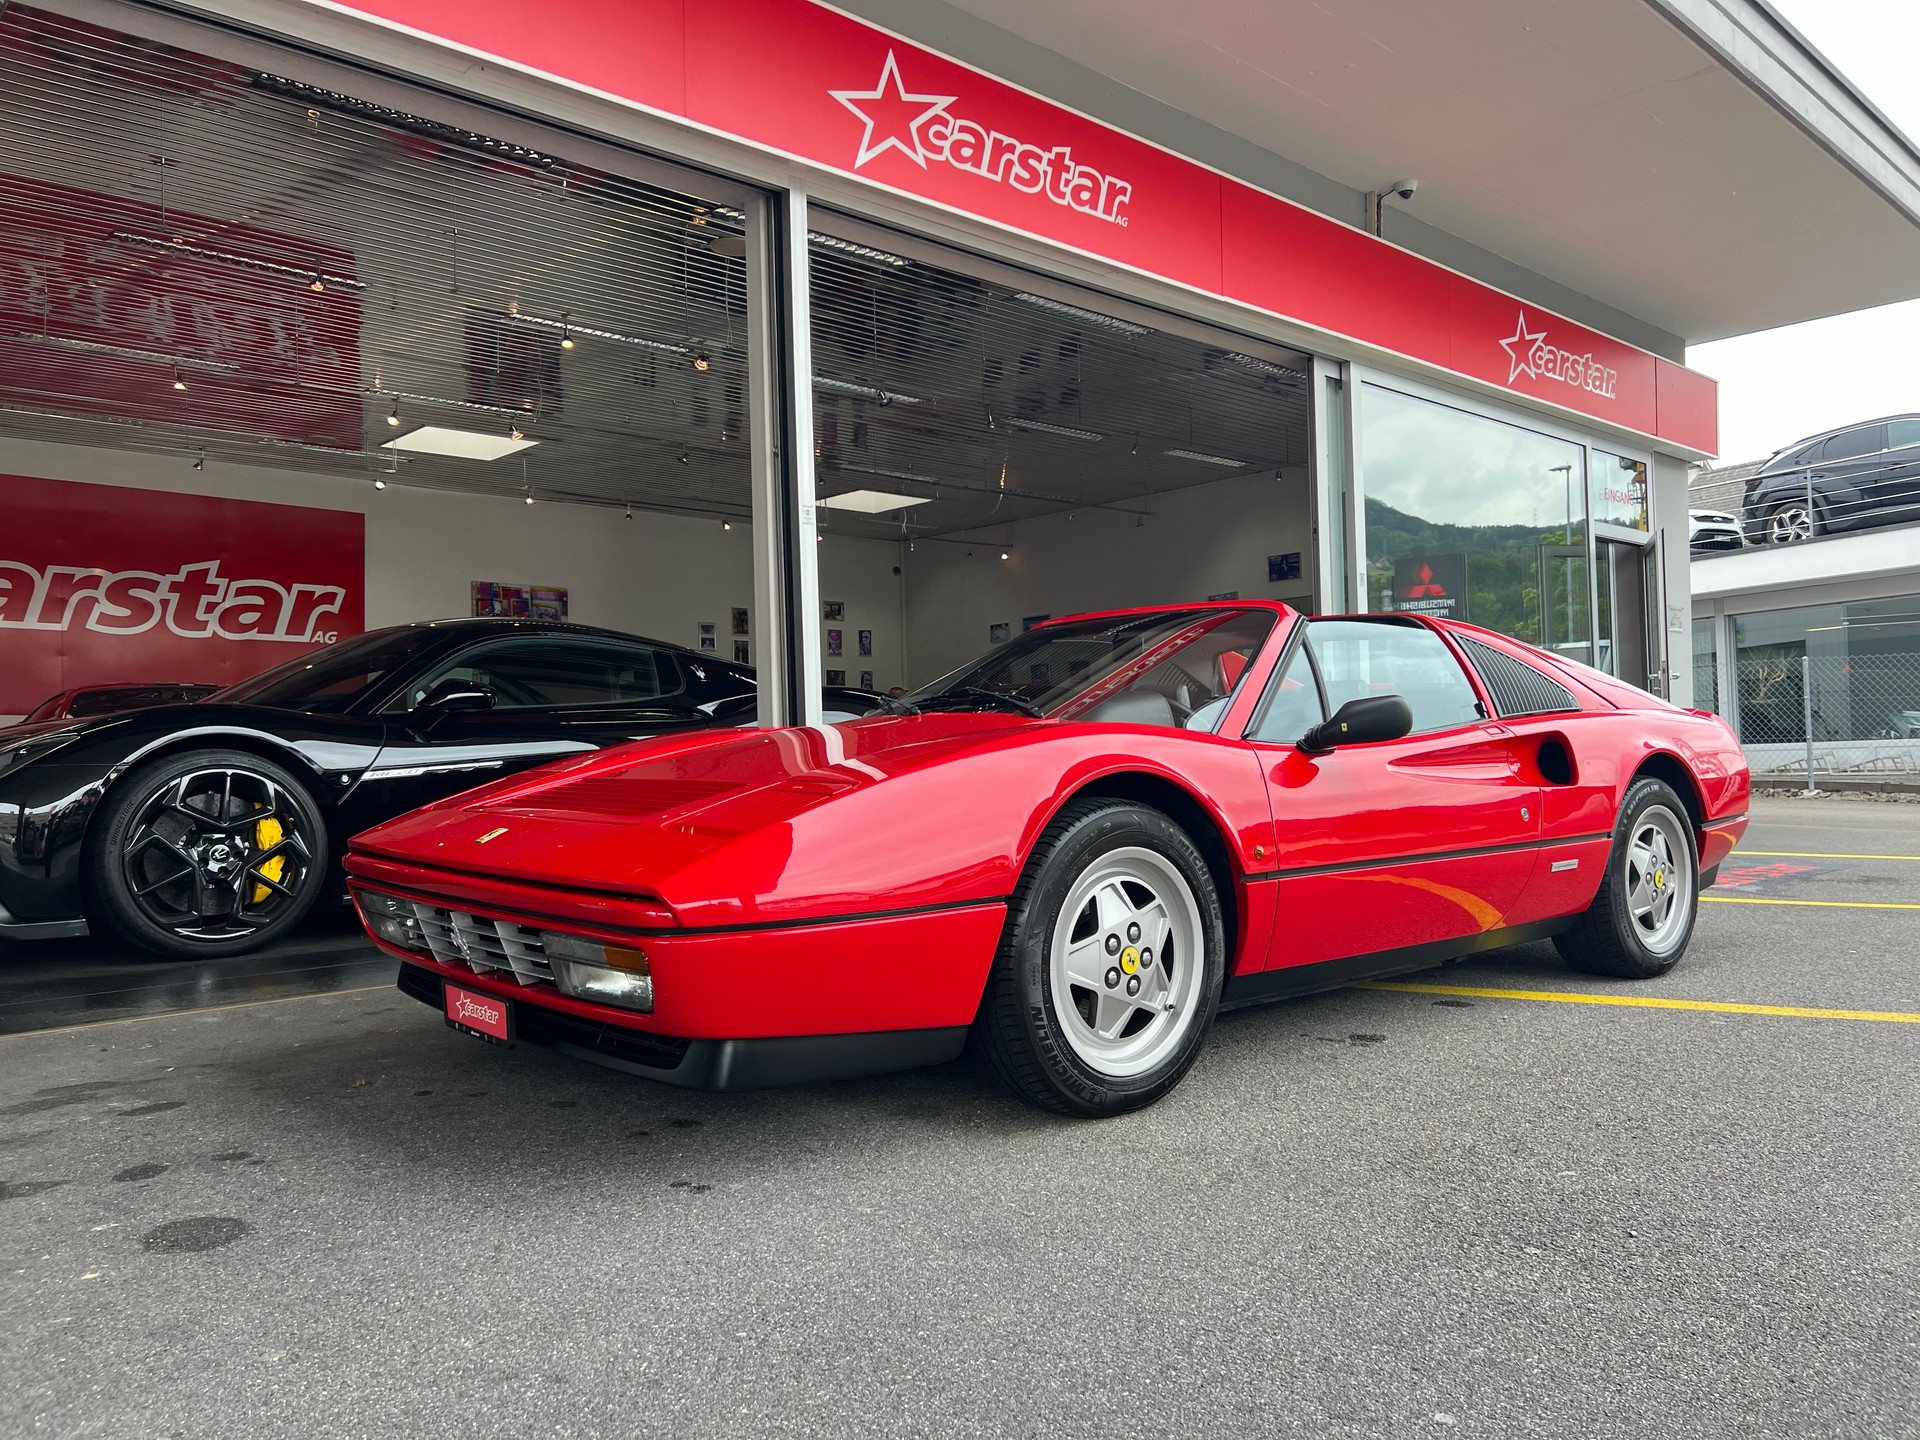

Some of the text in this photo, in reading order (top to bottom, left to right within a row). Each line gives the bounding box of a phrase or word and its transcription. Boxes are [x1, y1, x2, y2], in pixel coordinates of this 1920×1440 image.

[912, 110, 1132, 227] carstar AG
[1530, 342, 1617, 397] carstar
[1604, 487, 1634, 506] EINGANG
[311, 631, 337, 644] AG
[1177, 834, 1223, 921] MICHELIN
[466, 1003, 498, 1024] carstar
[1030, 1004, 1087, 1100] MICHELIN
